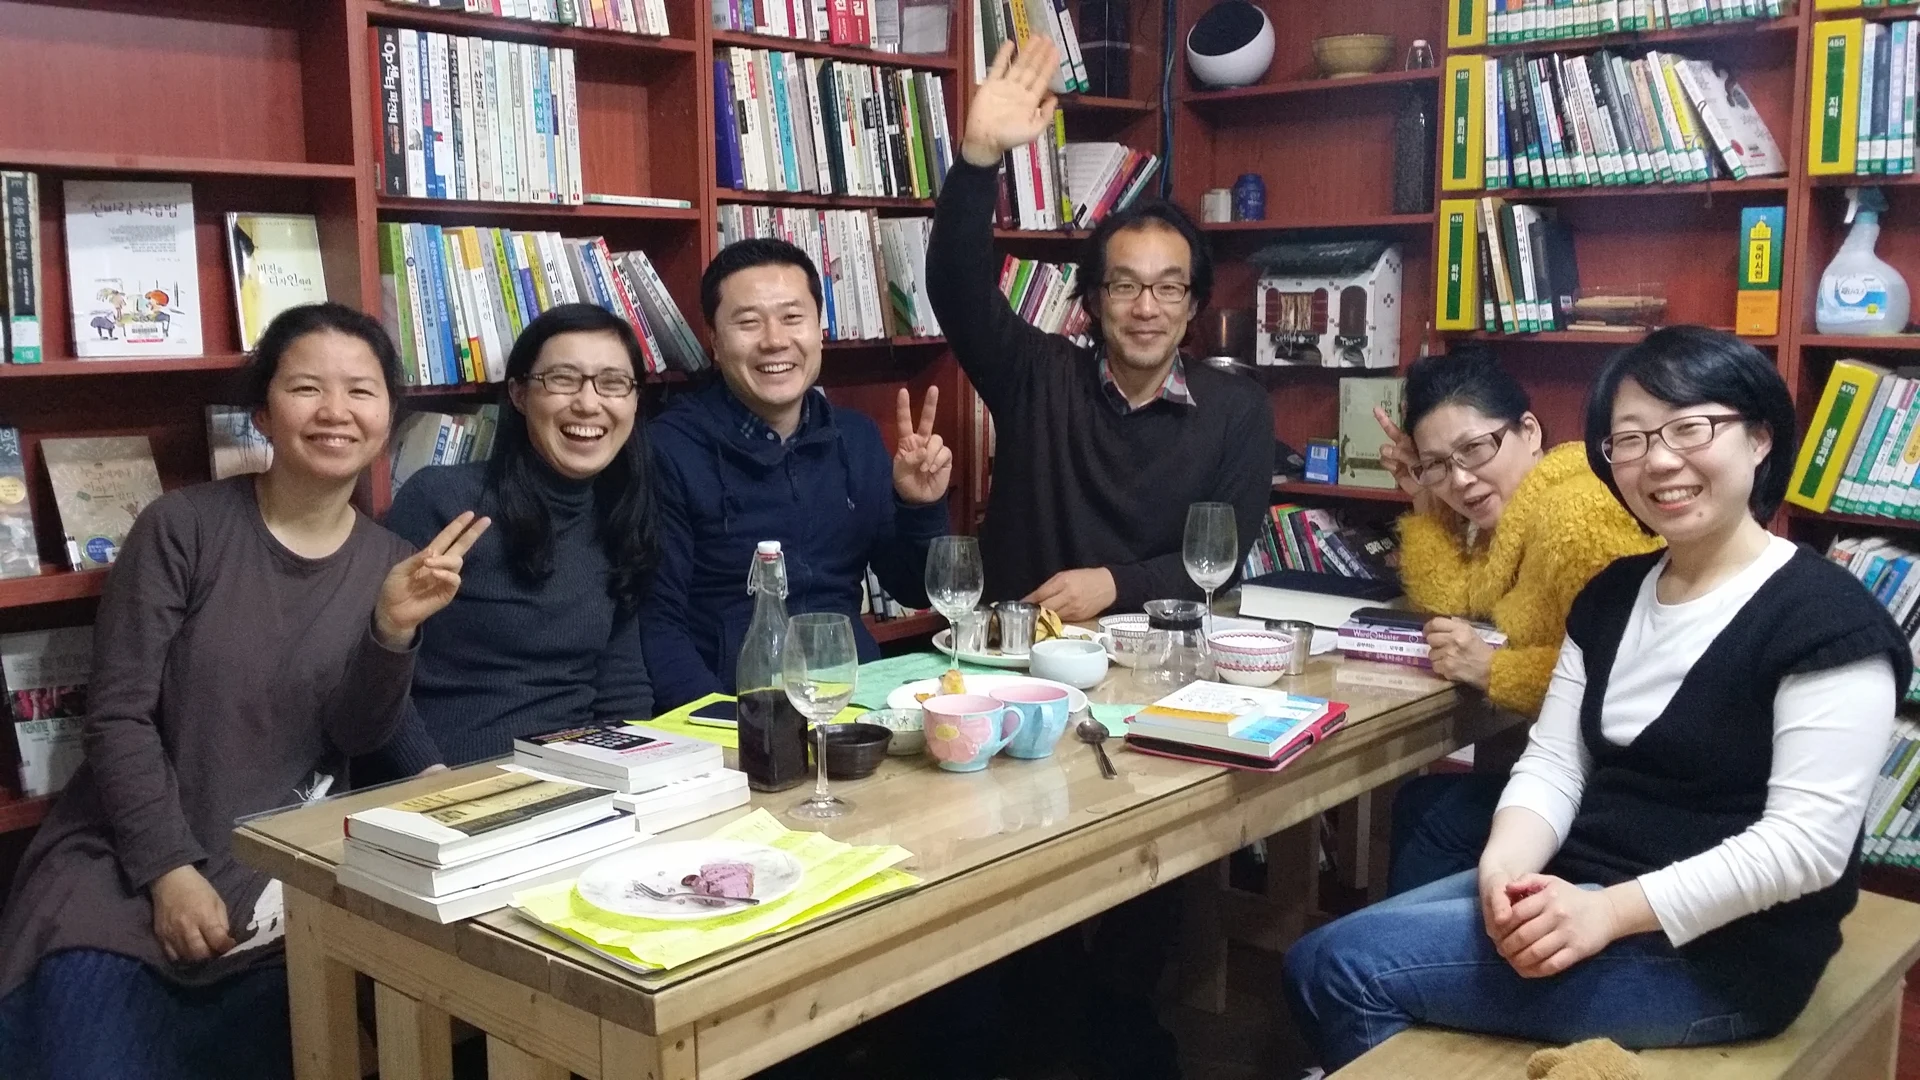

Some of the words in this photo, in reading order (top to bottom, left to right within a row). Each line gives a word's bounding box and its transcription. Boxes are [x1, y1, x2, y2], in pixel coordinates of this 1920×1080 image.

[1456, 70, 1469, 79] 420
[1828, 96, 1839, 119] 지학
[1456, 117, 1466, 145] 물리학
[138, 201, 178, 218] 학습법
[1450, 214, 1463, 223] 430
[1451, 263, 1460, 282] 화학
[1841, 384, 1856, 396] 470
[1353, 629, 1370, 639] Word
[1377, 633, 1400, 642] Master
